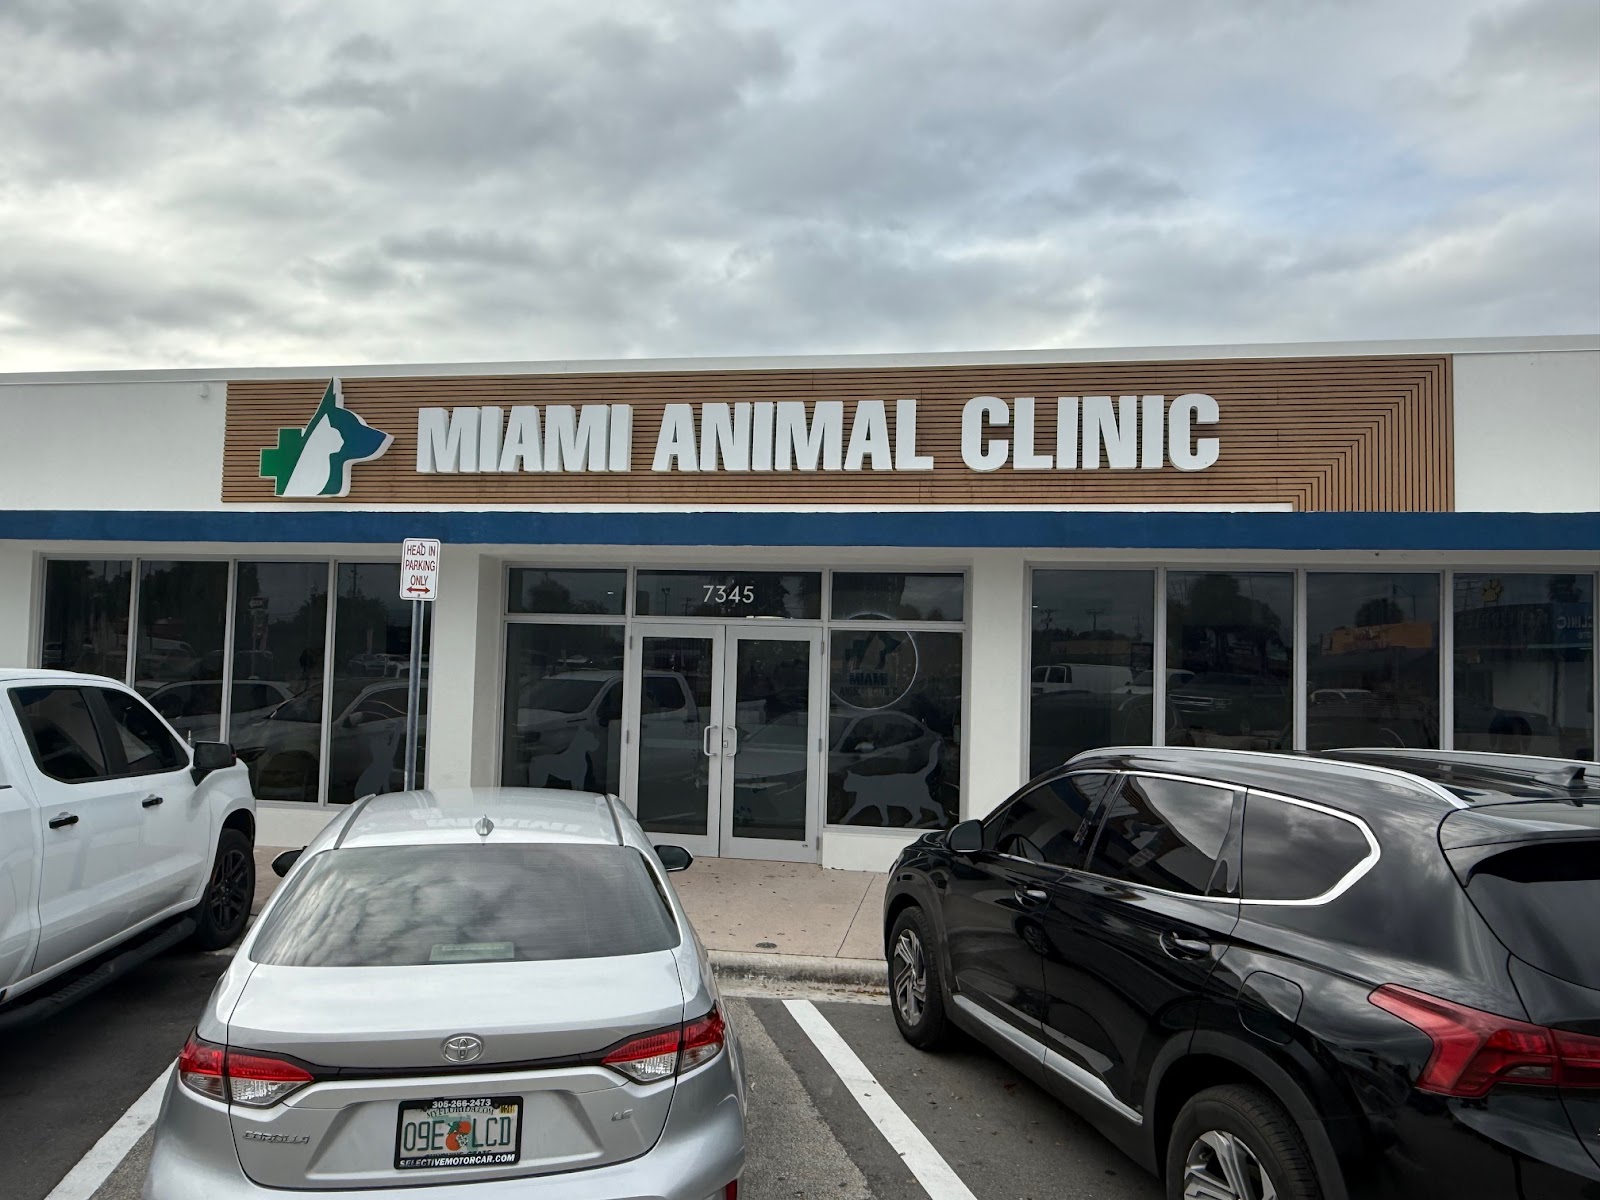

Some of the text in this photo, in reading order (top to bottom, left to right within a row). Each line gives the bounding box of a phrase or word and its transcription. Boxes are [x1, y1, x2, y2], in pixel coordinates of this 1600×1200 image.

[416, 393, 1220, 474] MIAMI ANIMAL CLINIC
[406, 544, 436, 557] HEAD IN
[405, 560, 436, 572] PARKING
[410, 575, 429, 586] ONLY
[703, 585, 754, 603] 7345
[404, 1117, 511, 1151] 09E LCD
[399, 1154, 515, 1167] SELECTIVEMOTORCAR.COM
